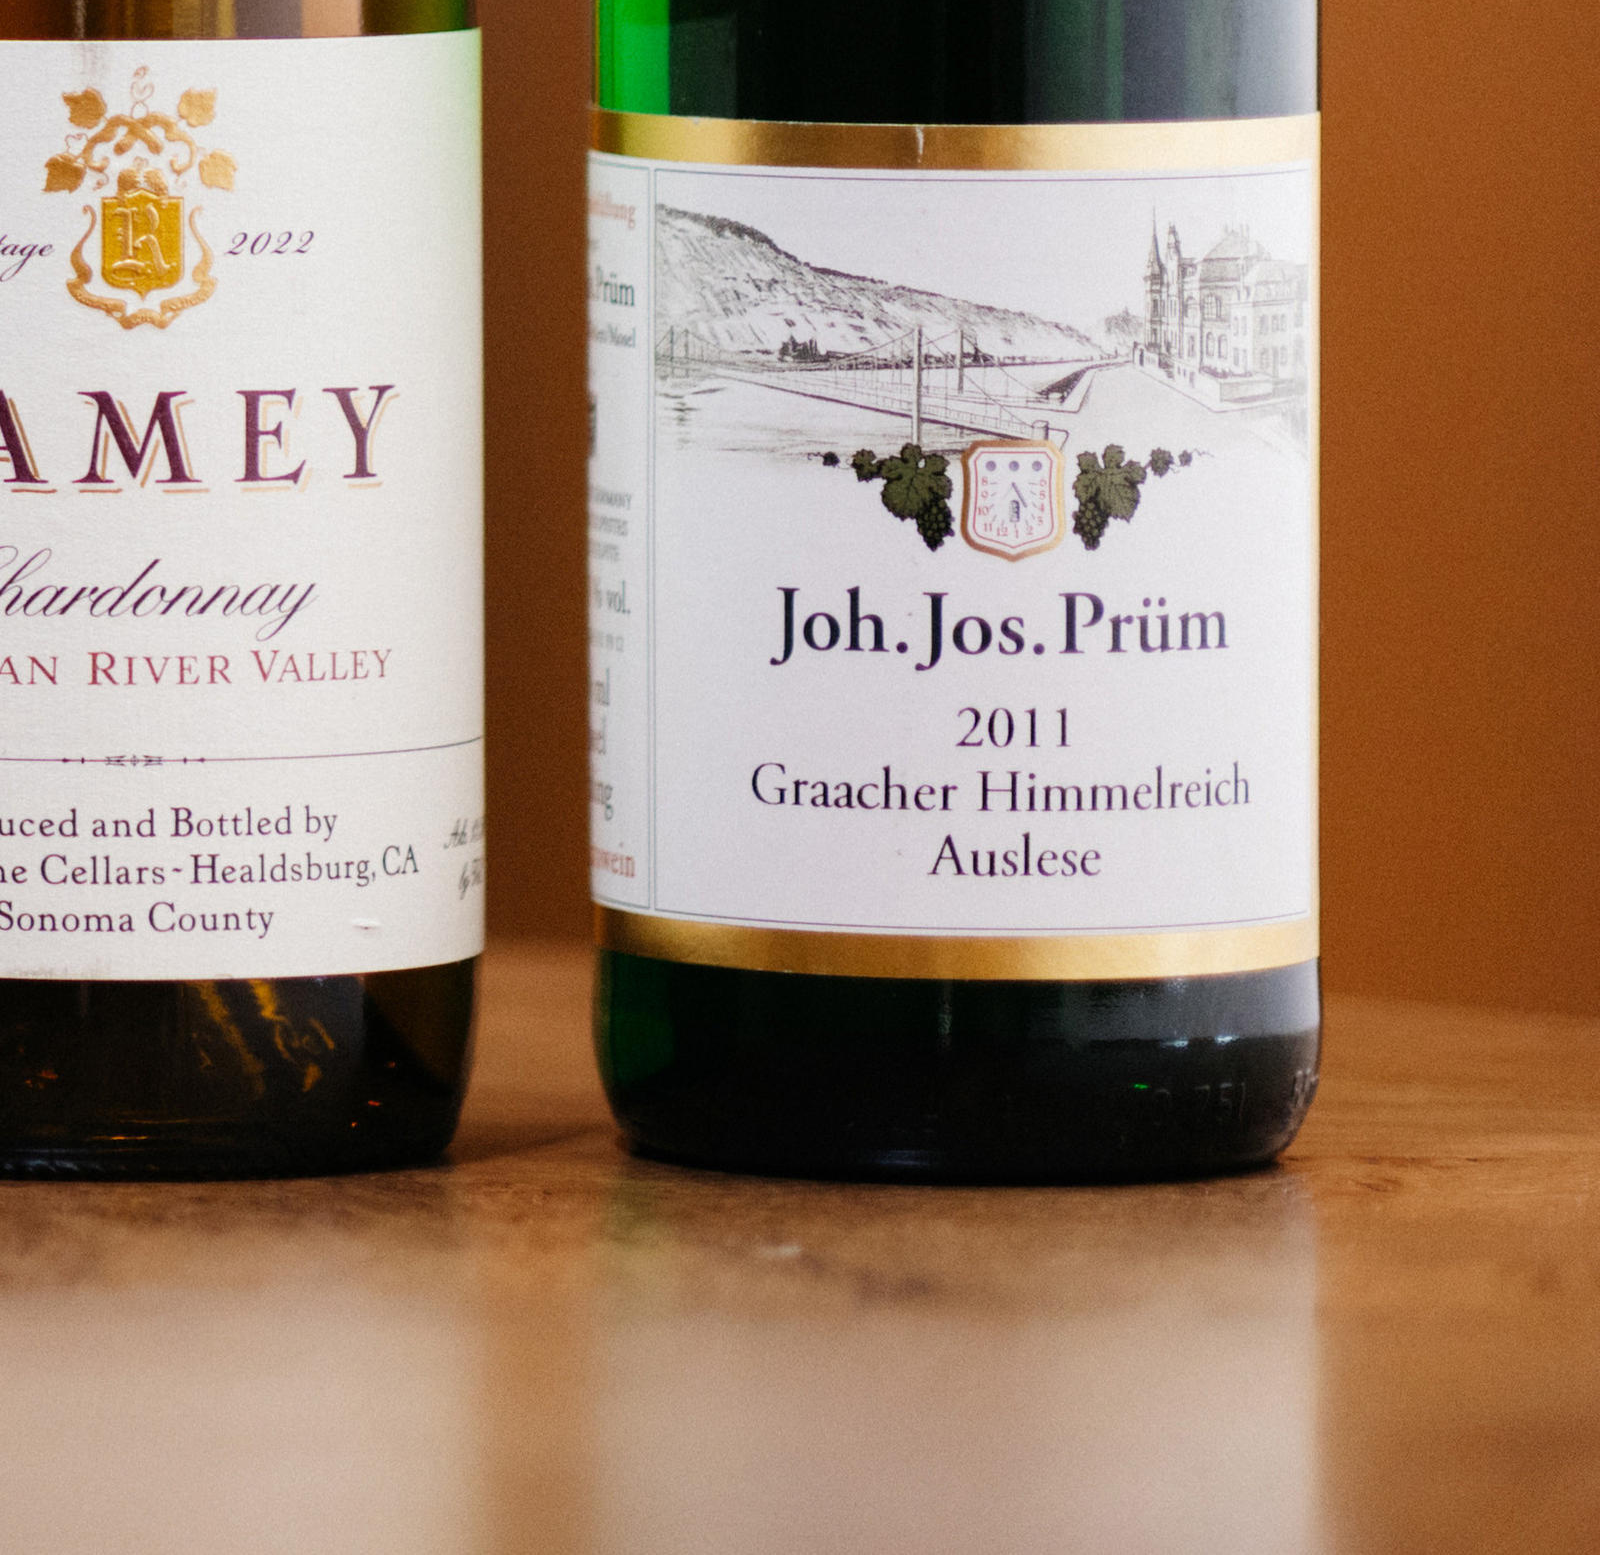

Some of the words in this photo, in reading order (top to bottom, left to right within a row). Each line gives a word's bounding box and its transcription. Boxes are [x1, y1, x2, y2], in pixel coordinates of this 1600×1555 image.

[222, 229, 316, 258] 2022
[770, 586, 909, 667] Joh.
[914, 591, 1046, 672] Jos.
[1058, 591, 1230, 654] Prüm
[88, 650, 233, 687] RIVER
[248, 647, 393, 684] VALLEY
[955, 706, 1073, 749] 2011
[750, 761, 958, 814] Graacher
[977, 760, 1252, 814] Himmelreich
[91, 806, 161, 840] and
[171, 805, 294, 839] Bottled
[305, 805, 339, 844] by
[40, 852, 165, 886] Cellars
[382, 844, 420, 877] CA
[926, 831, 1102, 879] Auslese
[148, 900, 275, 939] County
